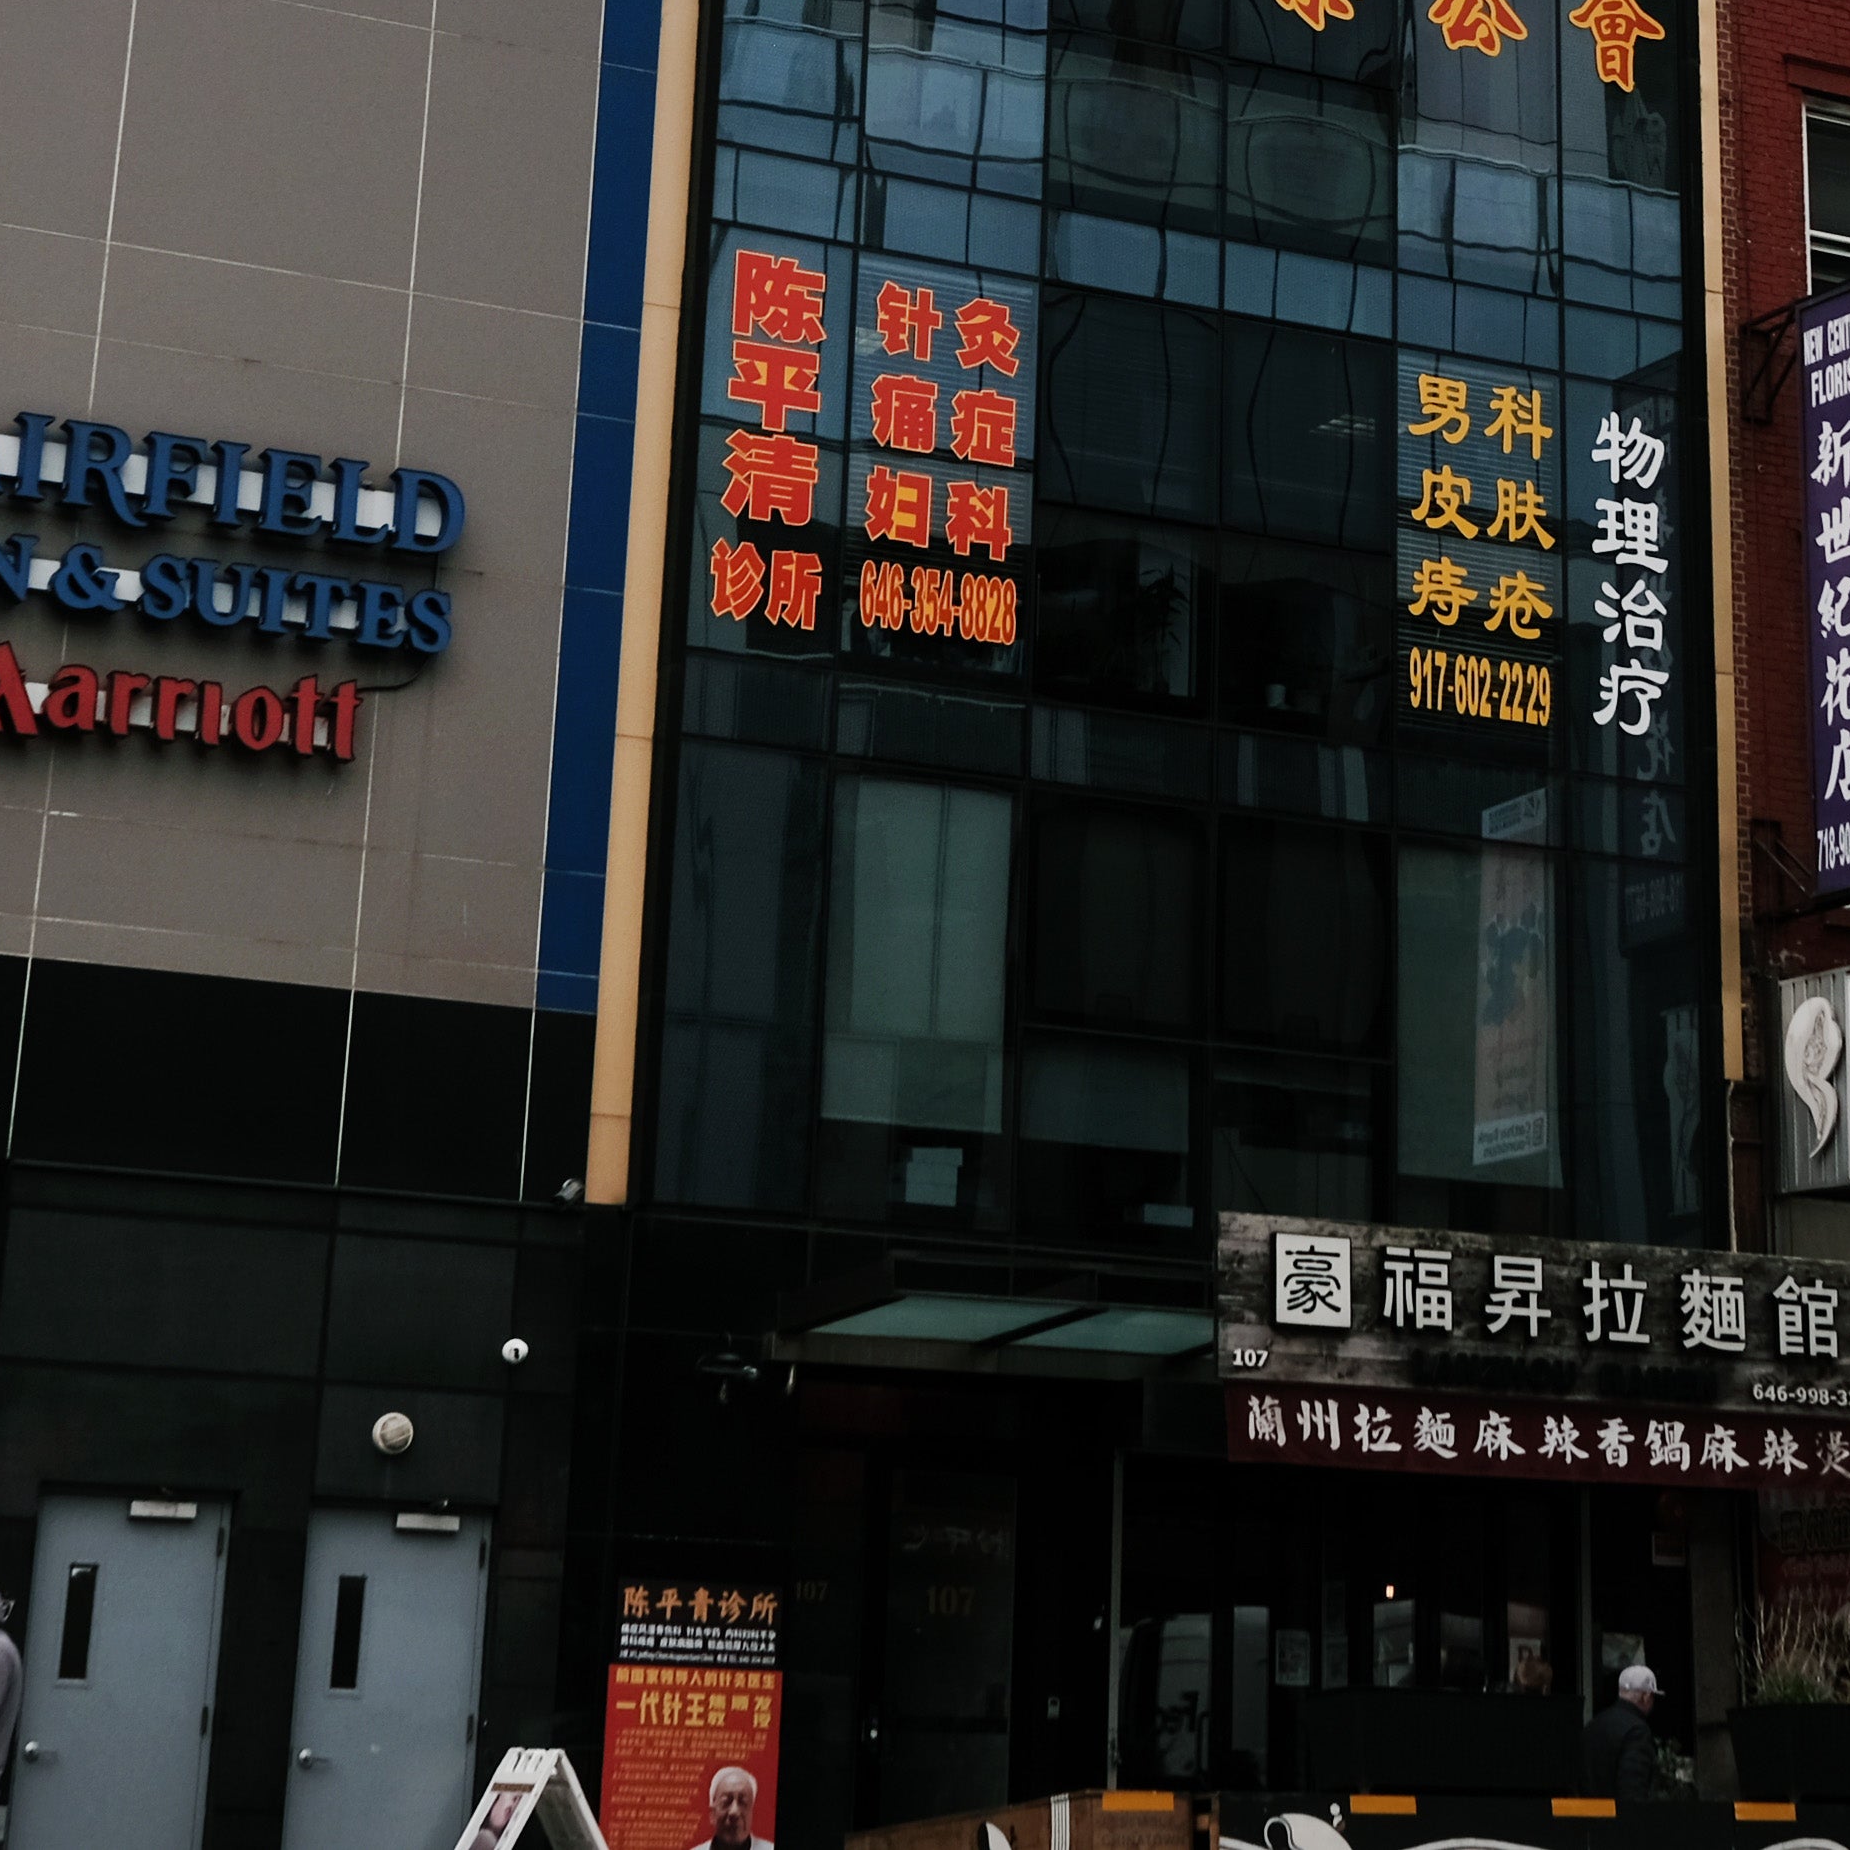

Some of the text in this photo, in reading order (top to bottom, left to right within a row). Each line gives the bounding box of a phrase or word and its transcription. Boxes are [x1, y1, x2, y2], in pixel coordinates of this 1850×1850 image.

[876, 280, 1020, 377] 针灸
[1803, 325, 1824, 366] NEW
[871, 374, 1017, 468] 痛症
[1408, 373, 1553, 461] 男科
[864, 464, 1012, 562] 妇科
[1411, 464, 1556, 550] 皮肤
[49, 543, 125, 613] &
[136, 552, 452, 654] SUITES
[859, 559, 1017, 645] 646-354-8828
[1591, 411, 1670, 736] 物理治疗
[1408, 646, 1551, 727] 917-602-2229
[1232, 1348, 1269, 1368] 107
